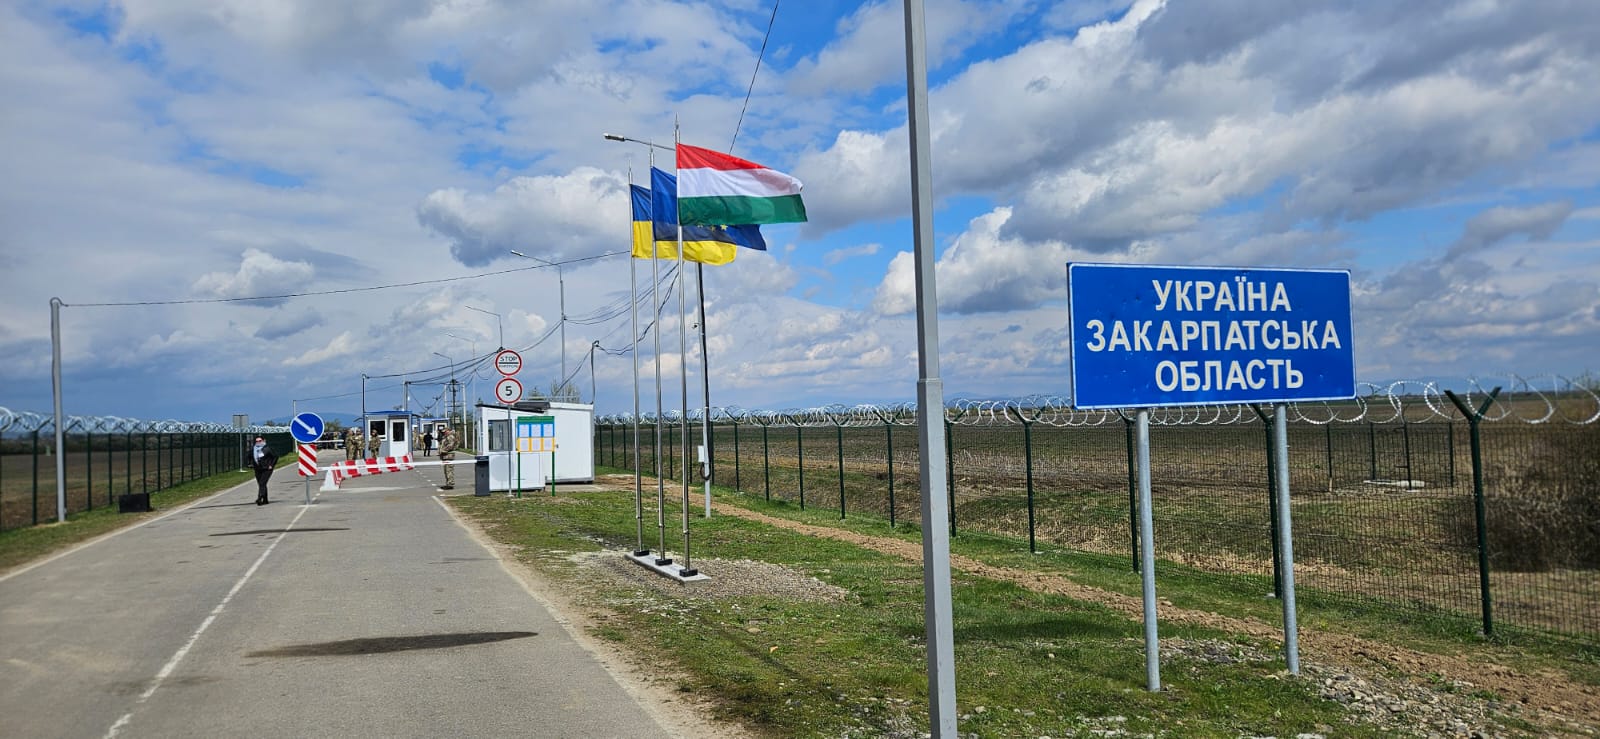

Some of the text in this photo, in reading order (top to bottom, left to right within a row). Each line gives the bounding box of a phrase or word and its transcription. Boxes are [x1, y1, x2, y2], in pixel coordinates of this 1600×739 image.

[1152, 276, 1291, 312] УКРАЇНА
[1086, 319, 1341, 352] ЗАКАРПАТСЬКА
[505, 385, 513, 396] 5
[1155, 359, 1304, 392] ОБЛАСТЬ
